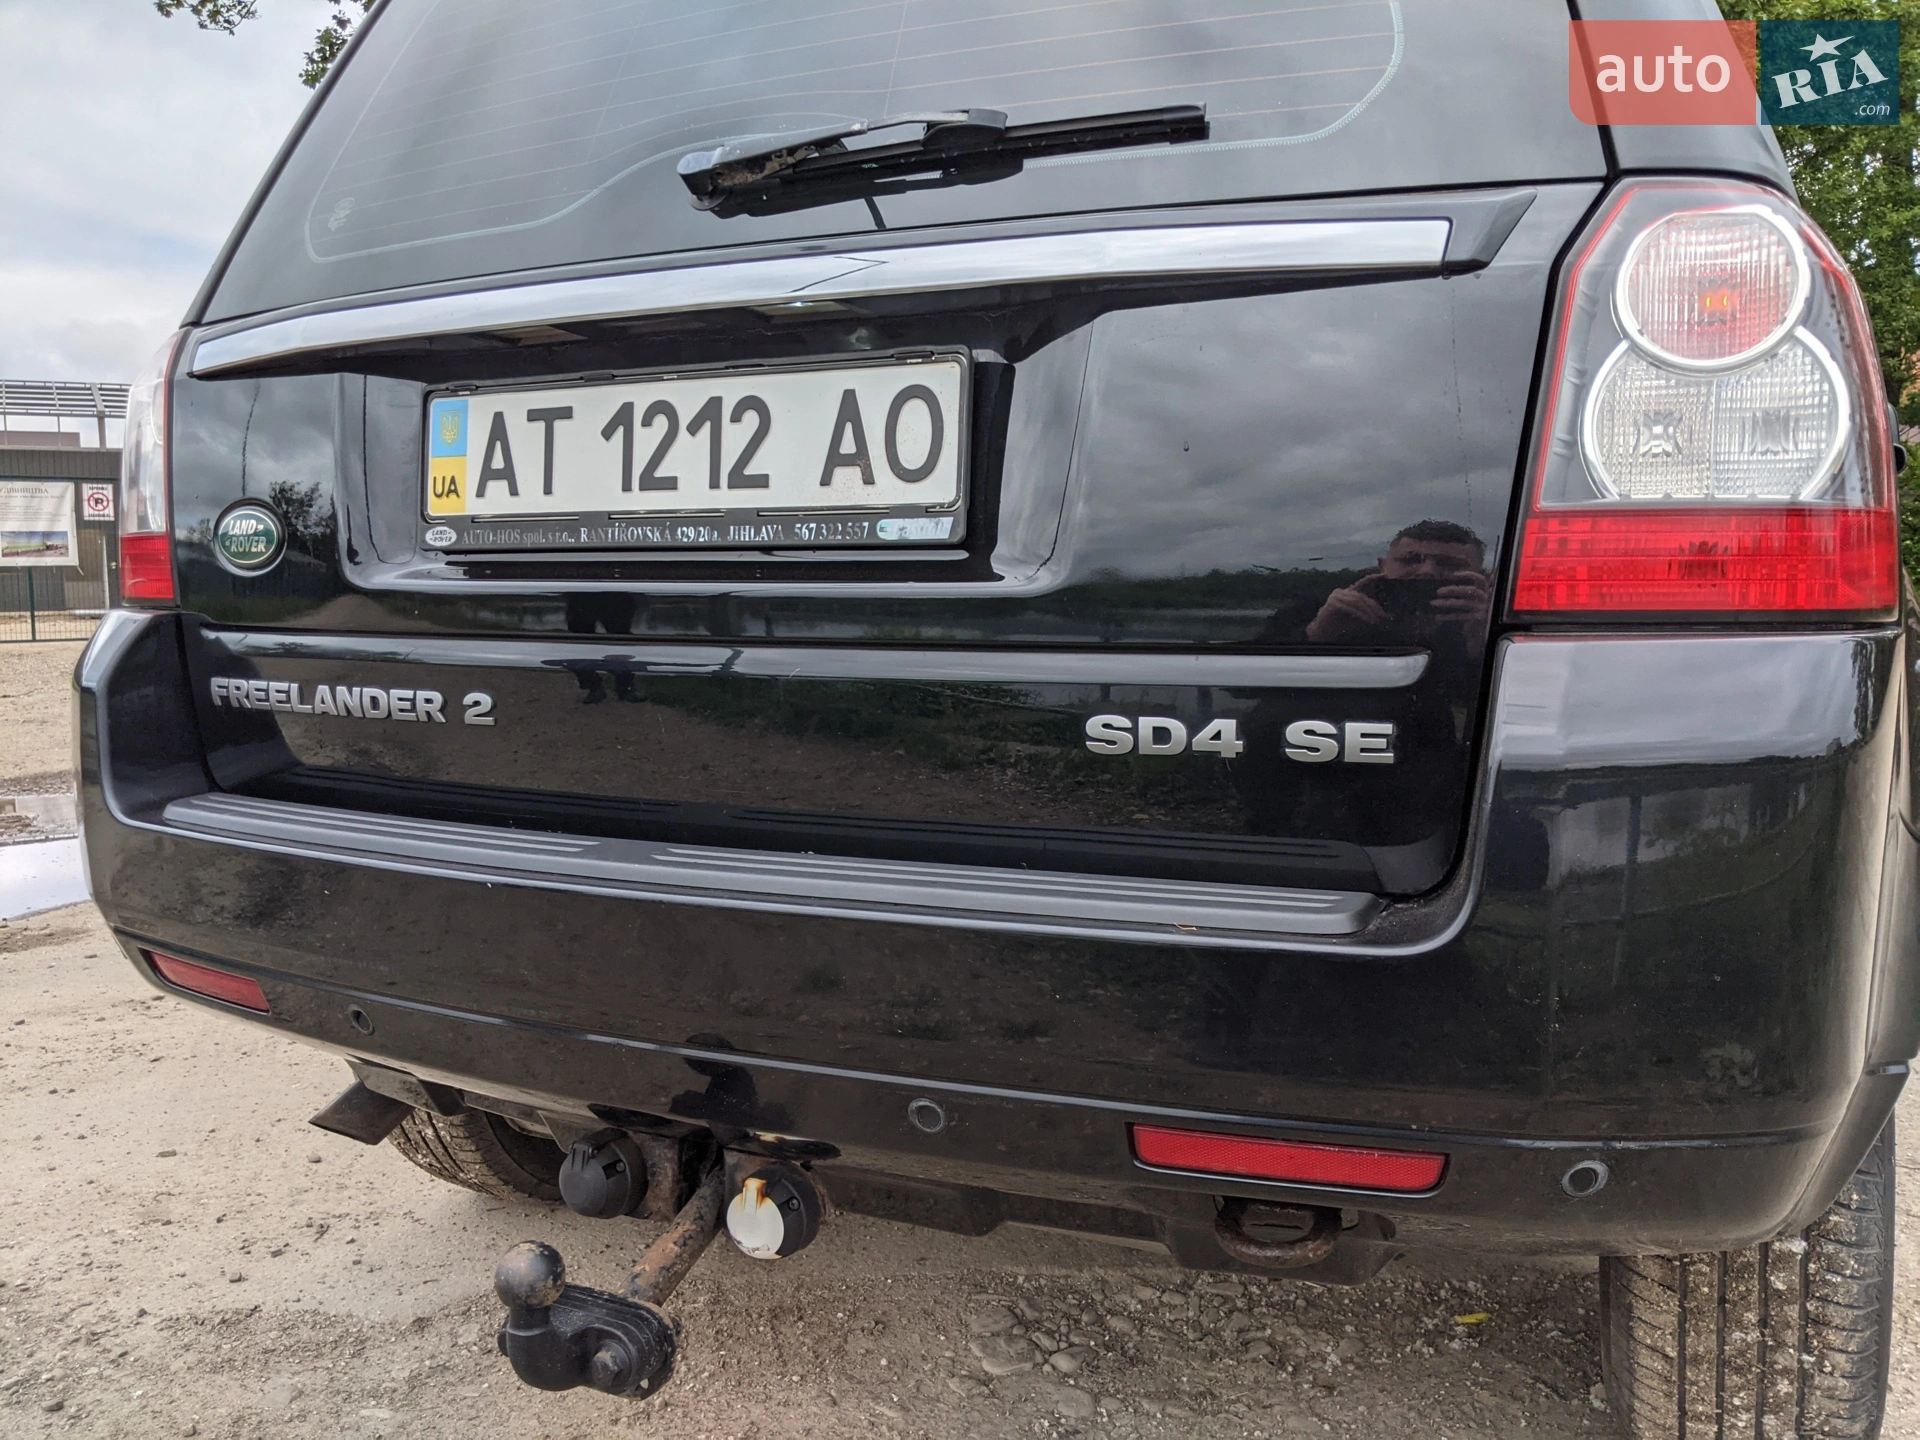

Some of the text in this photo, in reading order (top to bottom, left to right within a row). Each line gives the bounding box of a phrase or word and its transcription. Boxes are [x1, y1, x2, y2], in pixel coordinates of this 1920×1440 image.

[475, 383, 946, 498] AT 1212 AO
[432, 474, 461, 499] UA
[461, 528, 521, 545] AUTO-HOS
[727, 525, 785, 541] JIHLAVA
[794, 522, 817, 541] 567
[819, 522, 843, 540] 322
[846, 521, 870, 540] 557
[210, 677, 496, 726] FREELANDER 2
[1085, 714, 1395, 764] SD4 SE
